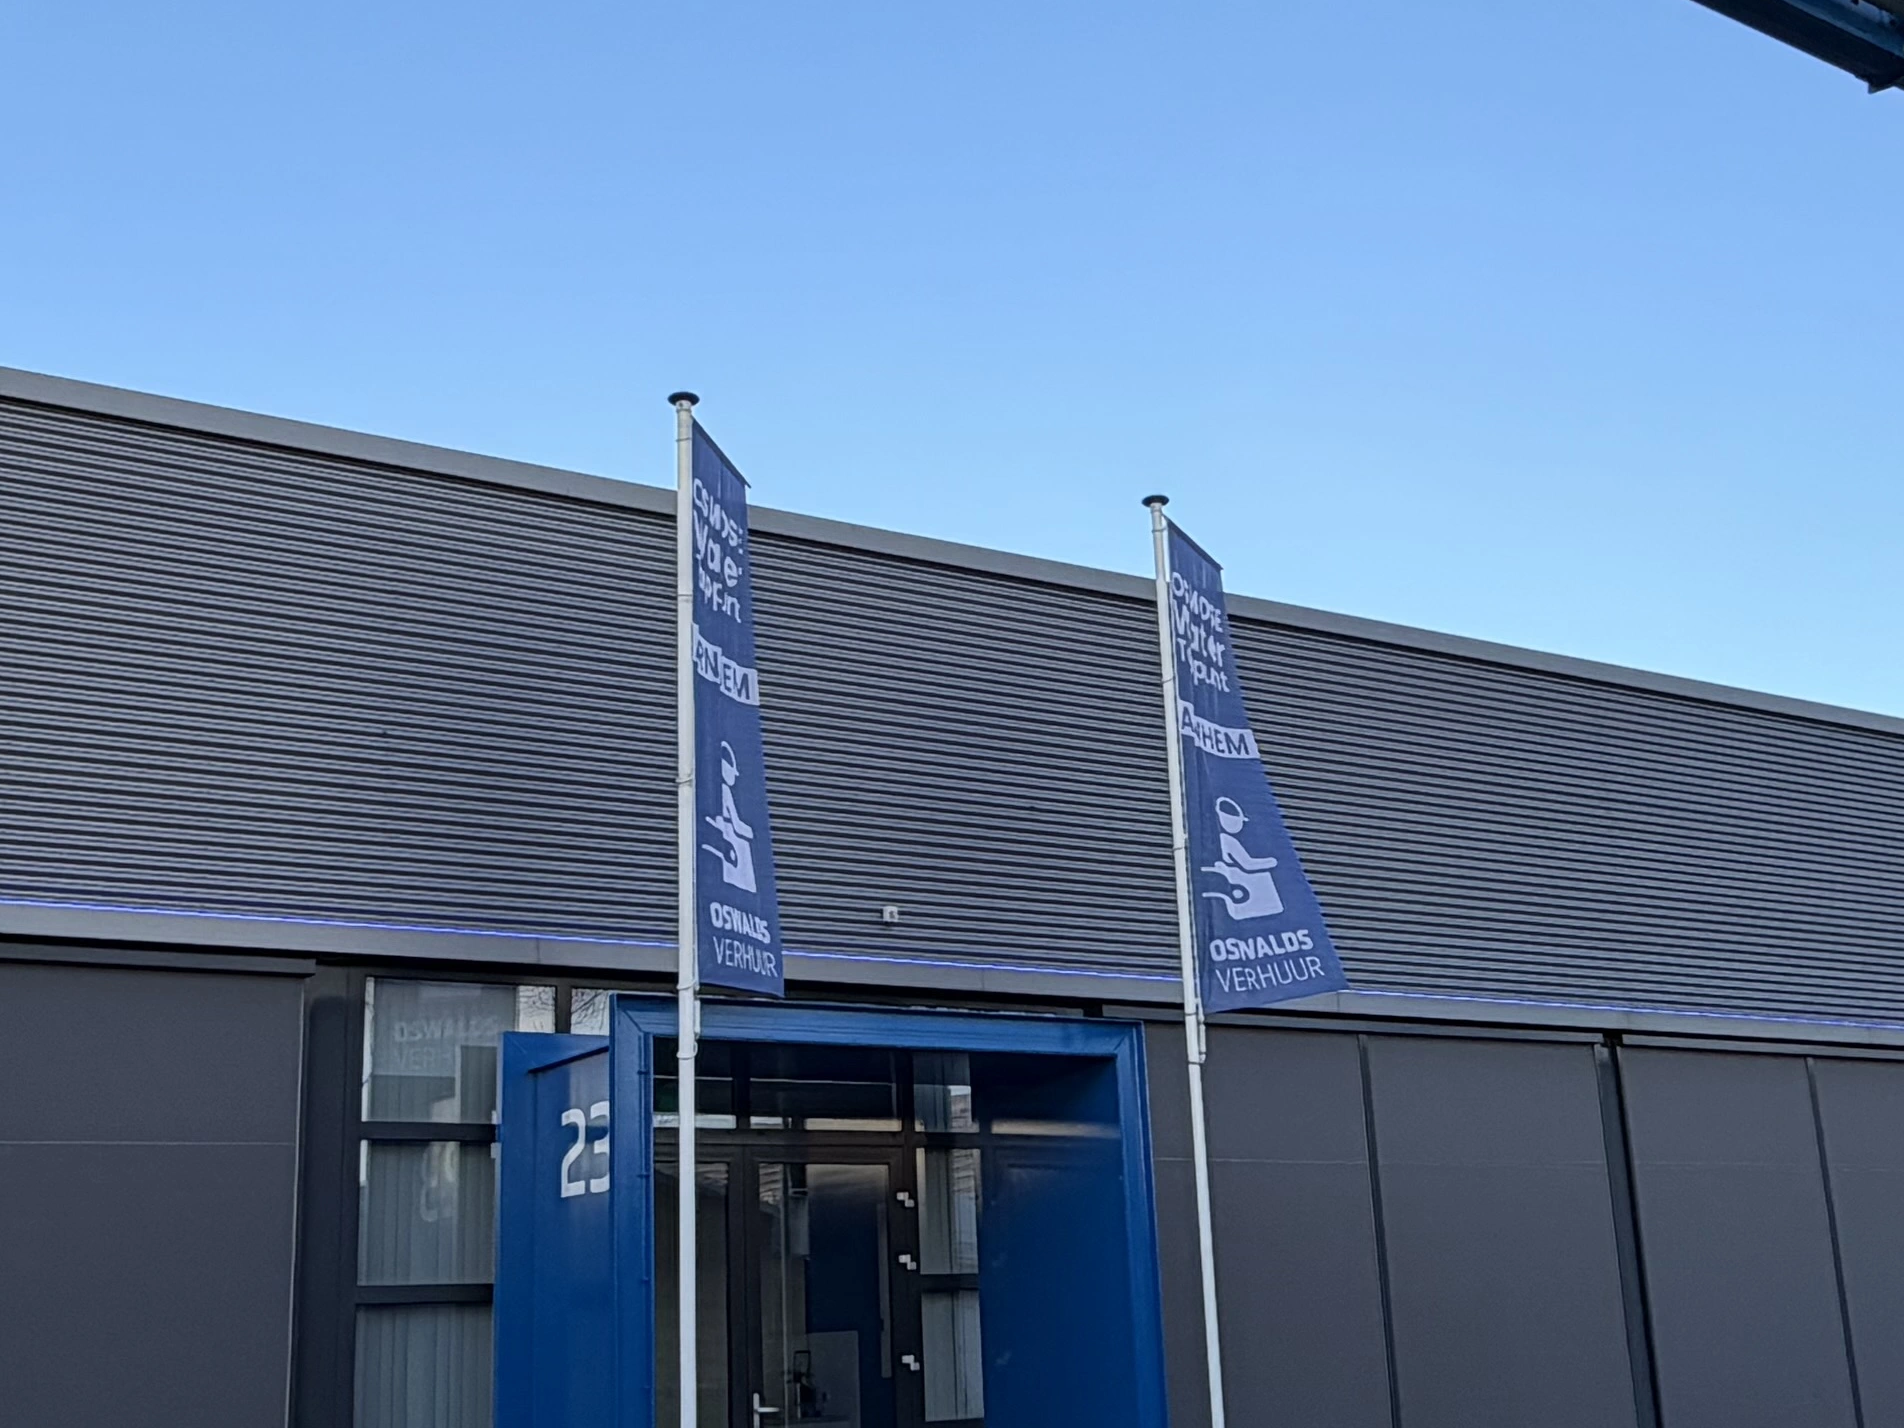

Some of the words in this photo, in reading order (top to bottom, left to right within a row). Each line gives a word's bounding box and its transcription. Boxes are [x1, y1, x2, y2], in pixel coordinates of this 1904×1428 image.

[1181, 706, 1250, 756] AHEM
[1215, 956, 1325, 993] VERHUUR
[560, 1100, 610, 1198] 23
